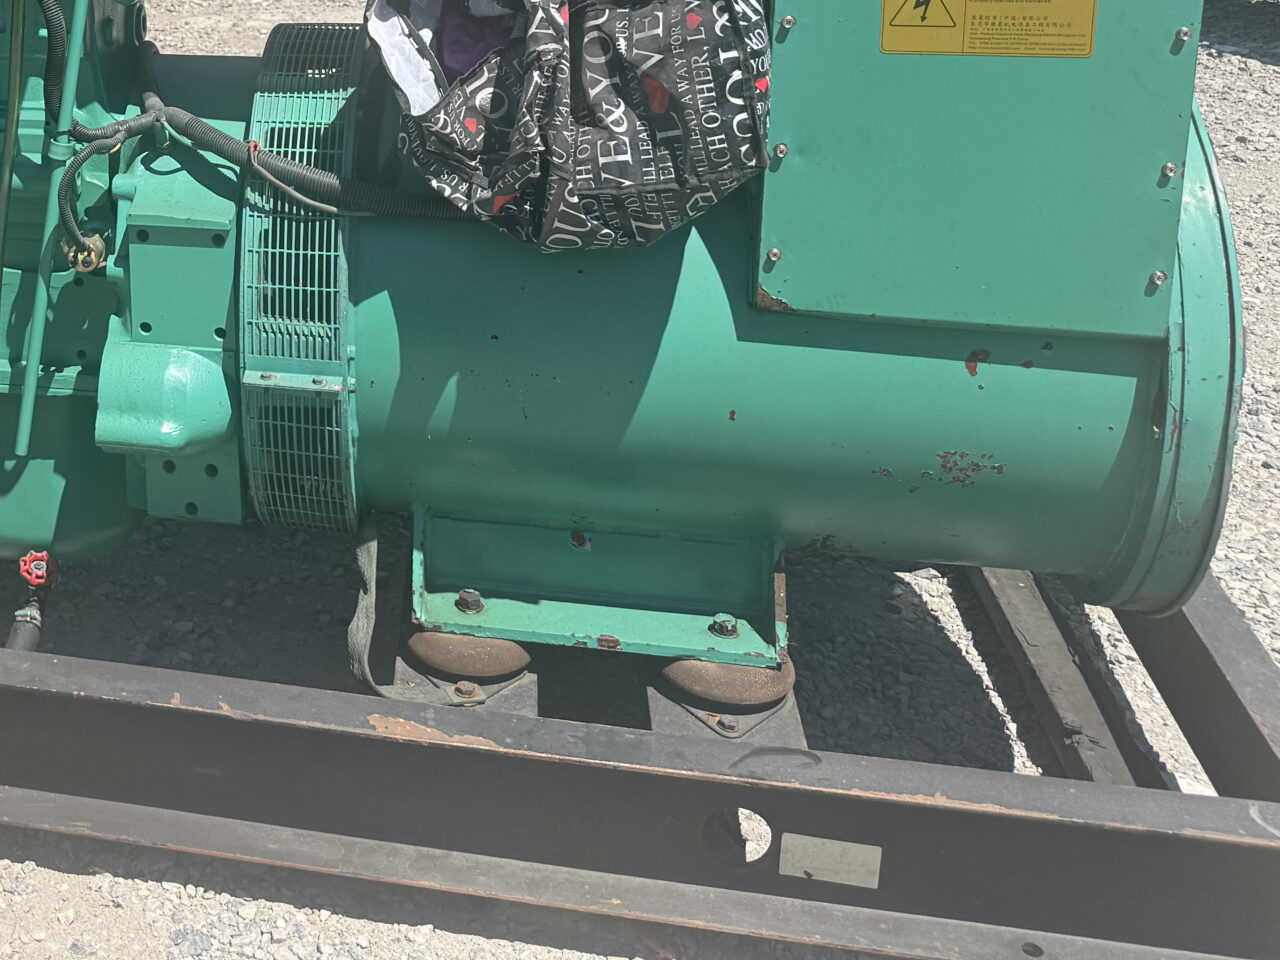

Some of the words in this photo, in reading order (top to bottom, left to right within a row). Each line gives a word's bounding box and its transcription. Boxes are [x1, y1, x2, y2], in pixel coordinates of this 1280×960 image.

[670, 26, 684, 54] FOR
[674, 57, 691, 93] WAY
[637, 120, 654, 159] LEAD
[684, 109, 703, 149] LEAD
